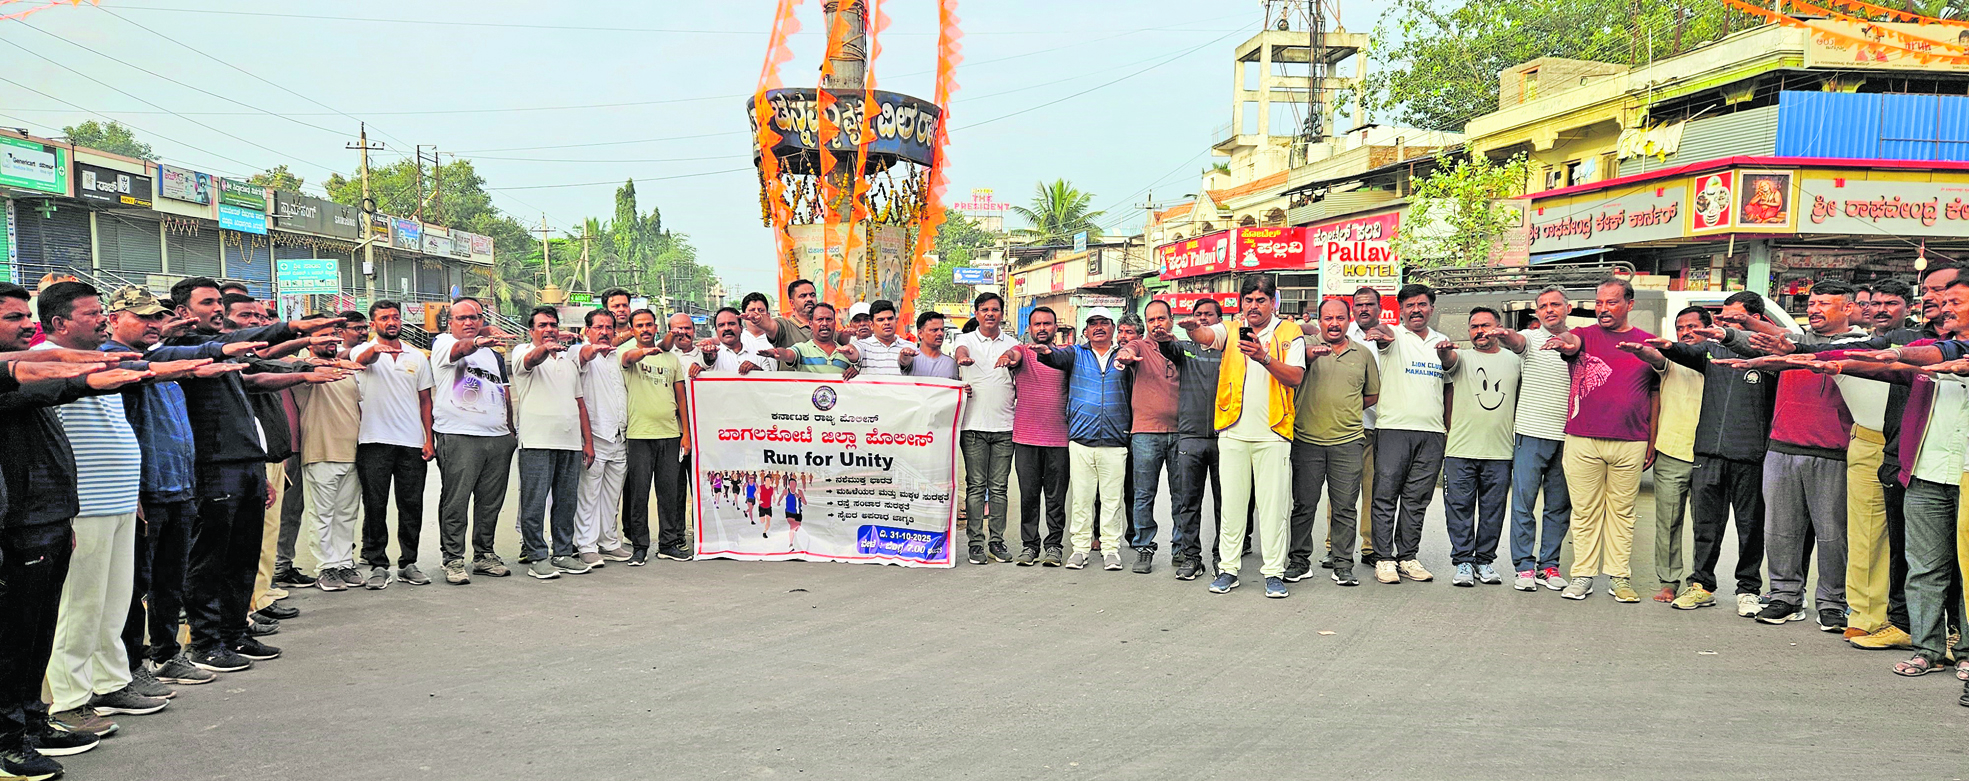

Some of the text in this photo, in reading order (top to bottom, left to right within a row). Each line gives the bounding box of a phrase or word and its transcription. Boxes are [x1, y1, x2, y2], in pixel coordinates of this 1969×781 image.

[972, 195, 993, 203] THE
[954, 202, 1011, 211] PRESIDENT
[1811, 194, 1837, 224] ಶ್ರೀ
[1844, 195, 1938, 227] ರಾಘವೇಂದ್ರ
[1543, 214, 1593, 240] ರಾಘವೇಂದ್ರ
[1628, 201, 1679, 228] ಕಾರ್ನರ್
[1257, 239, 1304, 258] ಪಲ್ಲವಿ
[1190, 245, 1216, 267] Pallavi
[1343, 264, 1400, 277] HOTEL
[771, 412, 810, 422] ಕರ್ನಾಟಕ
[814, 413, 836, 426] ರಾಜ್ಯ
[718, 425, 935, 450] ಬಾಗಲಕೋಟೆ ಜಿಲ್ಲಾ ಪೊಲೀಸ್
[763, 449, 894, 471] Run for Unity
[869, 477, 893, 485] ಭಾರತ
[878, 489, 897, 499] ಮತ್ತು
[899, 490, 920, 502] ಮಕ್ಕಳ
[922, 492, 950, 503] ಸುರಕ್ಷತೆ
[837, 499, 910, 512] ರಸ್ತೆ ಸಂಚಾರ ಸುರಕ್ಷತೆ
[861, 512, 890, 521] ಅಪರಾಧ
[890, 531, 932, 542] 31-10-2025
[907, 544, 926, 554] 7.00
